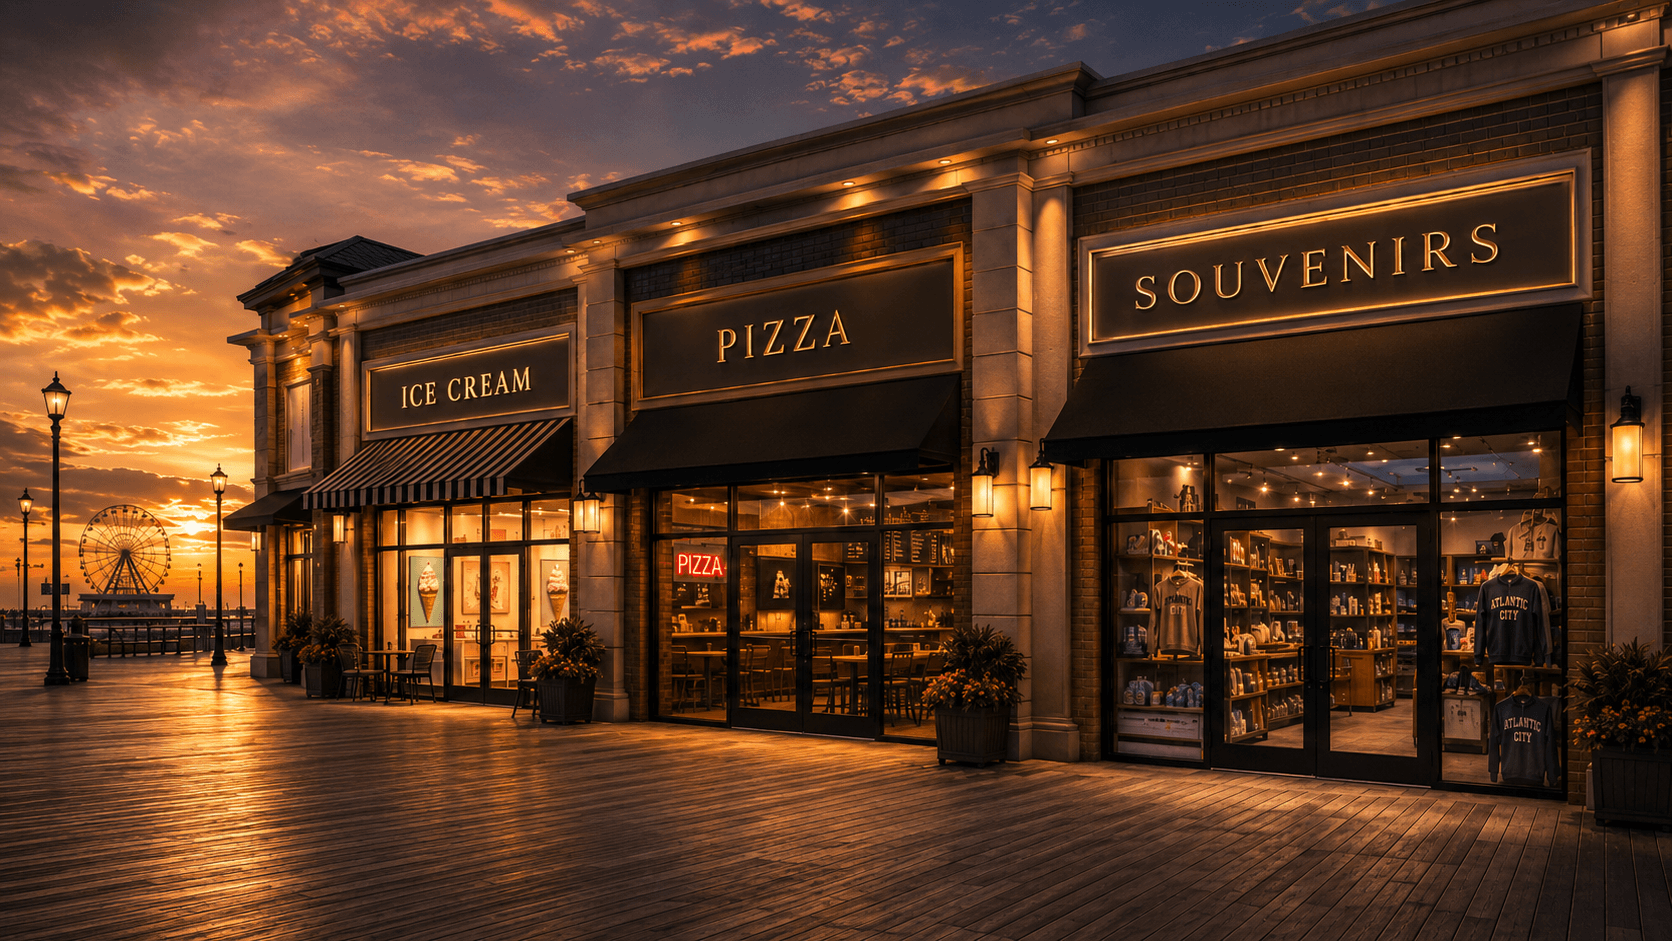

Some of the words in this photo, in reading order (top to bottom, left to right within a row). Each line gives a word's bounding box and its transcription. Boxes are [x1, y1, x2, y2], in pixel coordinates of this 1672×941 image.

[1134, 223, 1501, 312] SOUVENIRS
[716, 309, 851, 364] PIZZA
[400, 381, 437, 410] ICE
[447, 366, 532, 403] CREAM
[678, 553, 723, 576] PIZZA
[1491, 596, 1528, 610] ATLANTIC
[1499, 610, 1519, 620] CITY
[1504, 717, 1541, 732] ATLANTIC
[1514, 732, 1532, 743] CITY
